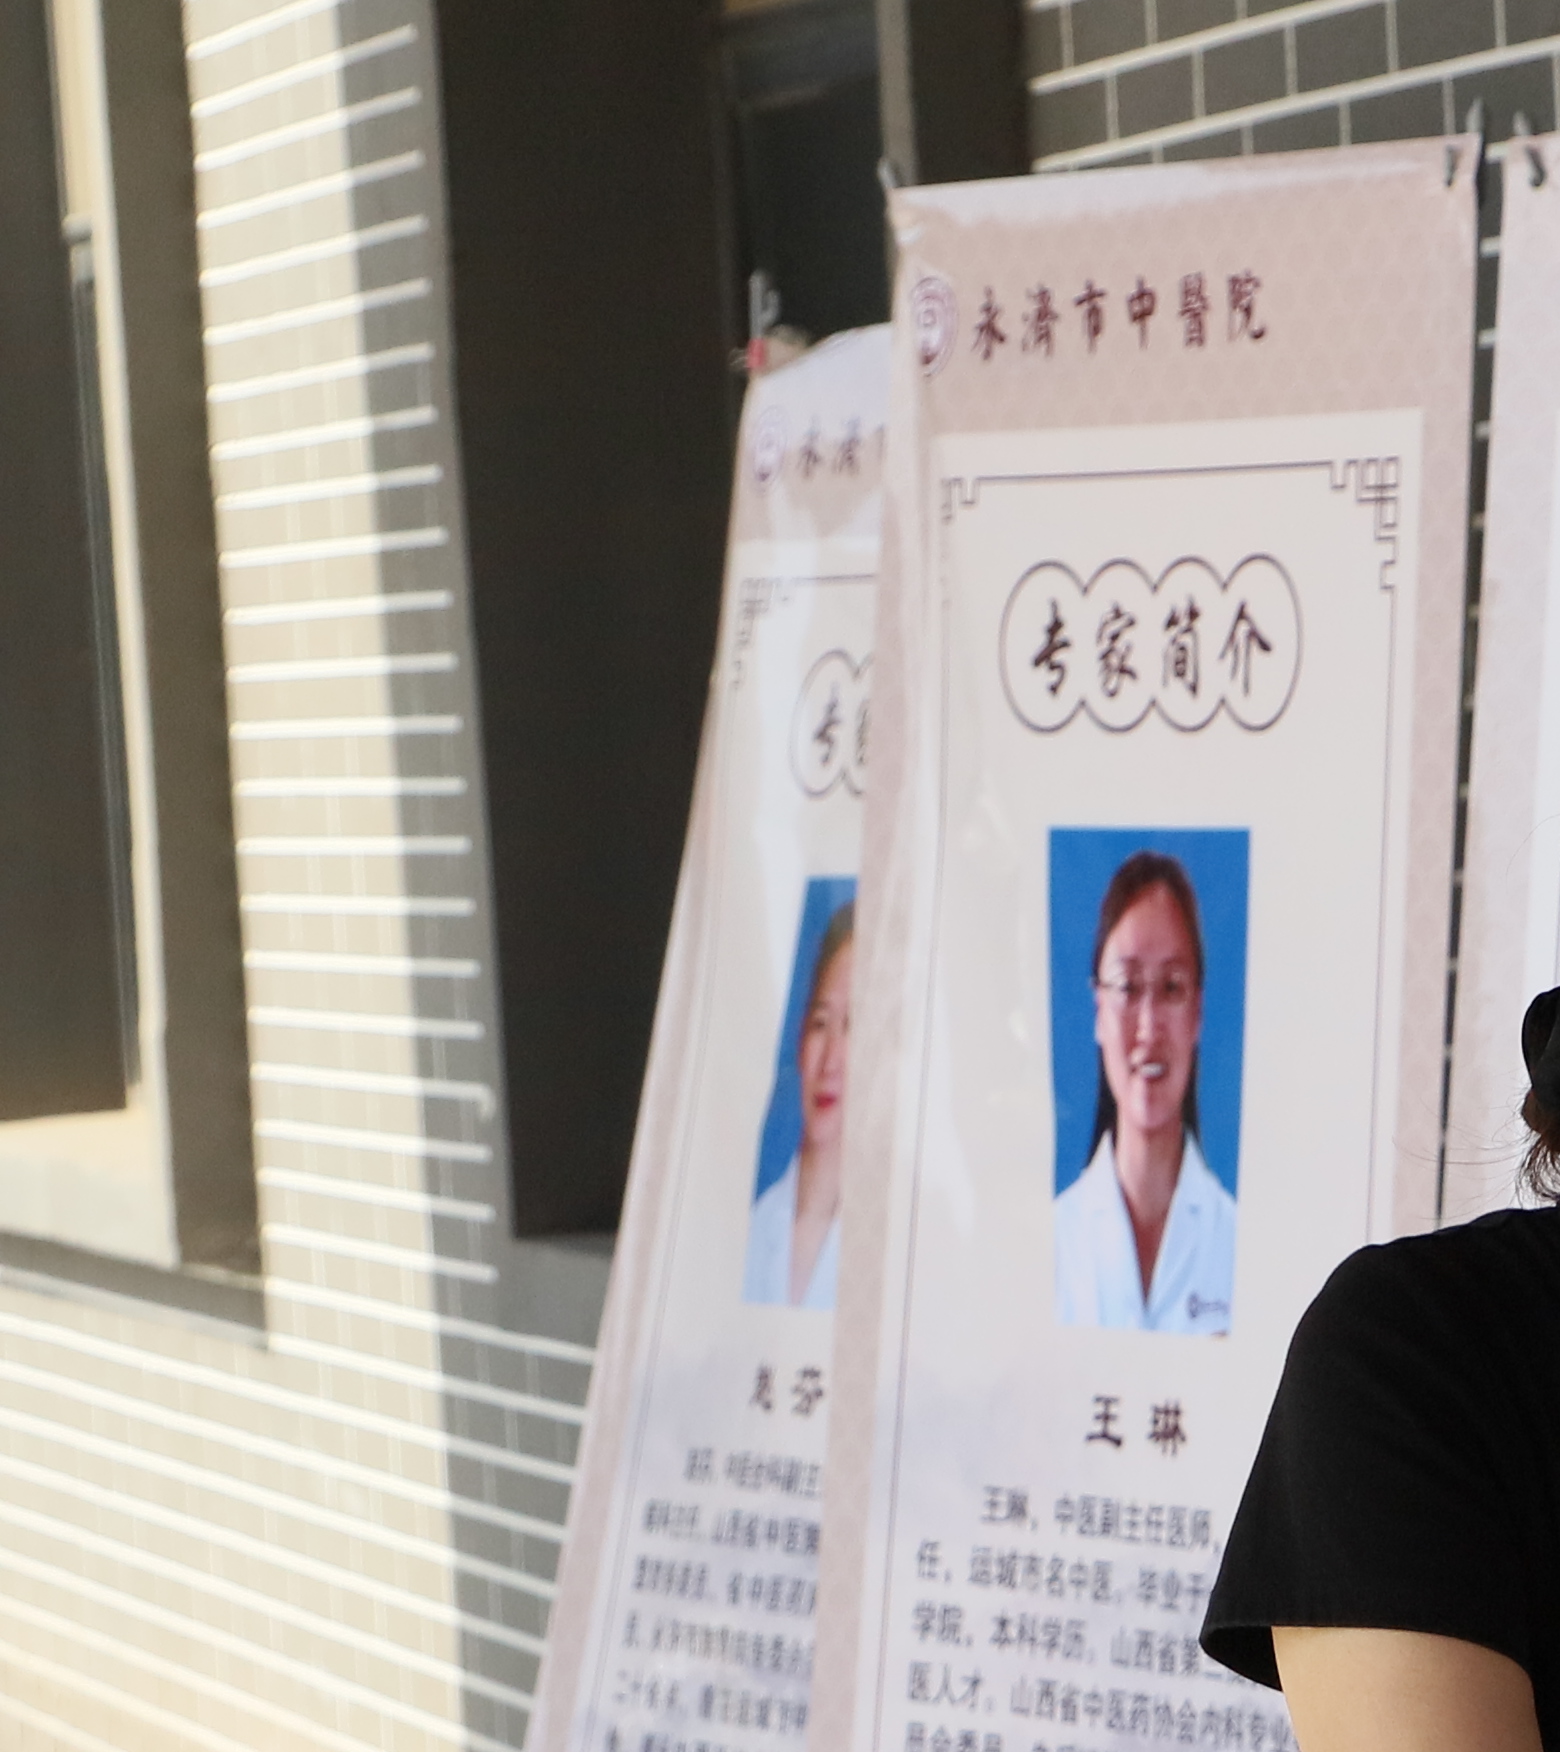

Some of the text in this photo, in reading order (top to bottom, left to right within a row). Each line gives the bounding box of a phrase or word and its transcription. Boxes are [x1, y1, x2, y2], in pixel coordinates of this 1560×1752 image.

[972, 272, 1268, 362] 永濟市中醫院
[1029, 595, 1274, 699] 专家简介
[1084, 1394, 1188, 1458] 王琳
